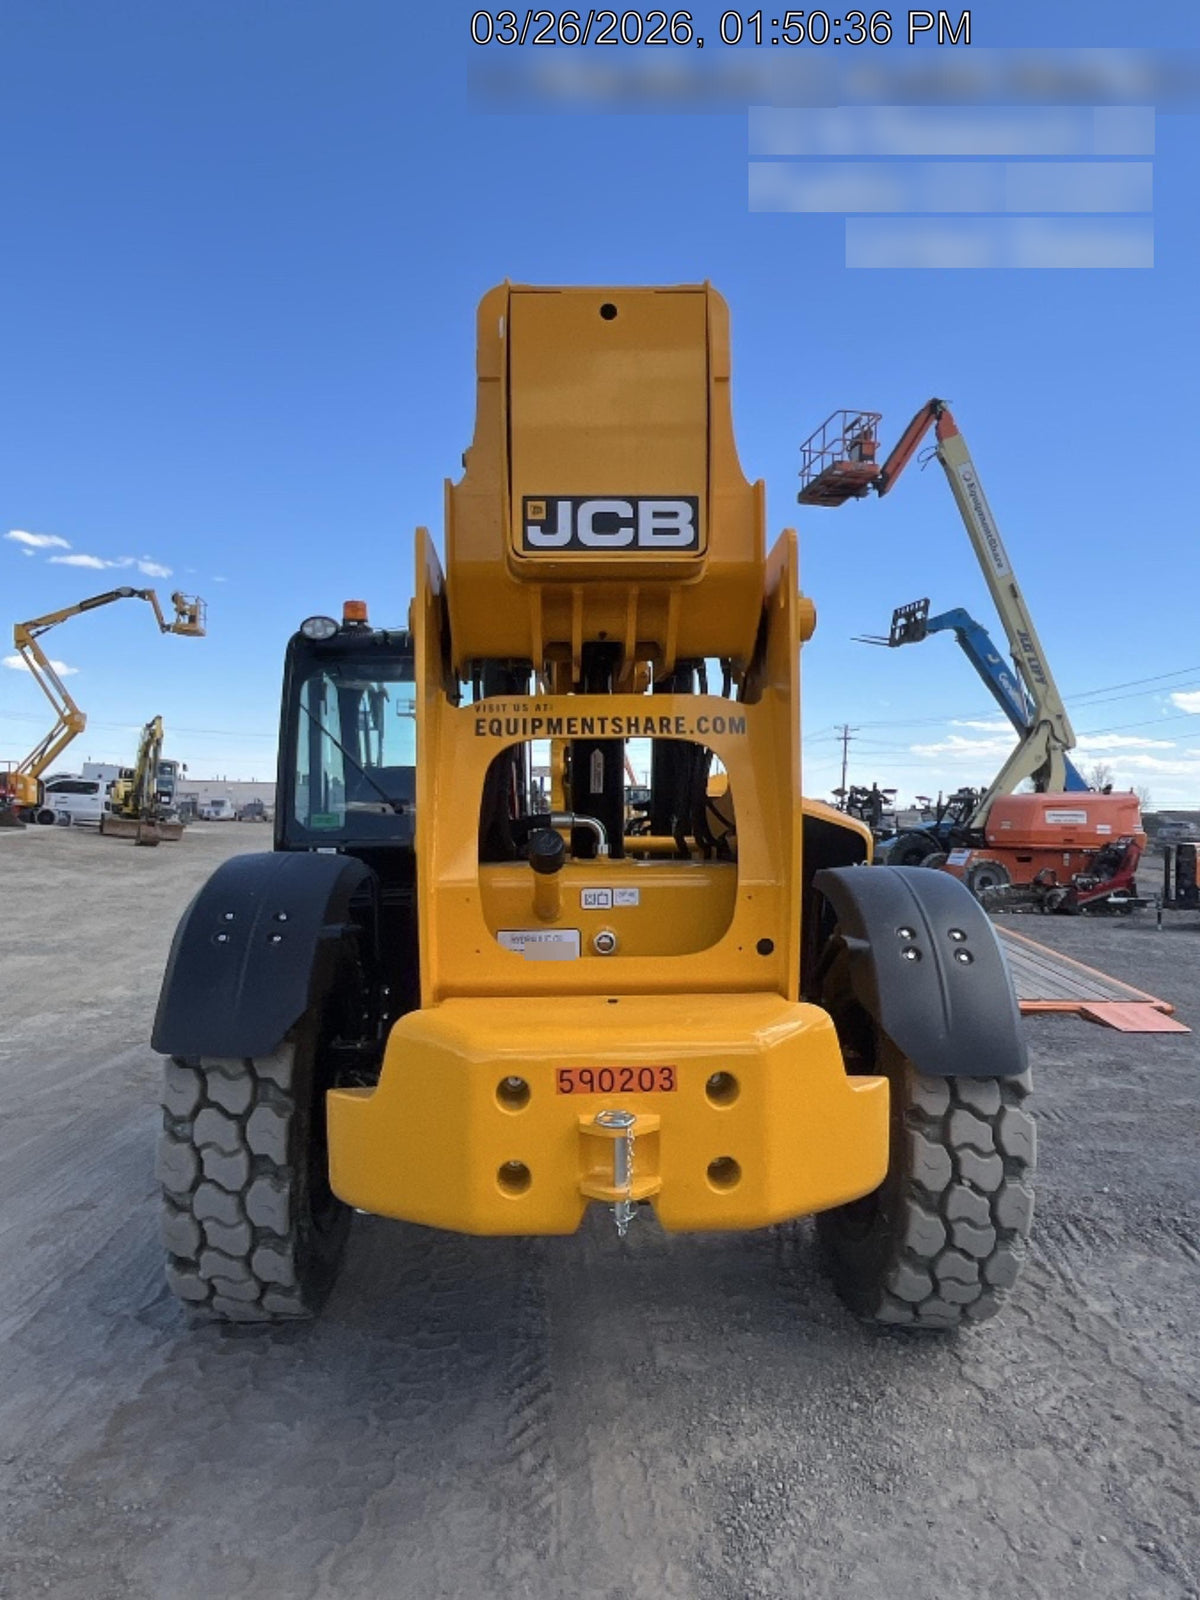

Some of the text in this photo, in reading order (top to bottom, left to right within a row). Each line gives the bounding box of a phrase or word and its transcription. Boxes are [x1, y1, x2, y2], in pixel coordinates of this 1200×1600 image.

[527, 500, 694, 547] JCB
[474, 703, 507, 713] VISIT
[513, 703, 529, 712] US
[474, 716, 746, 737] EQUIPMENTSHARE.COM
[559, 1066, 675, 1094] 590203
